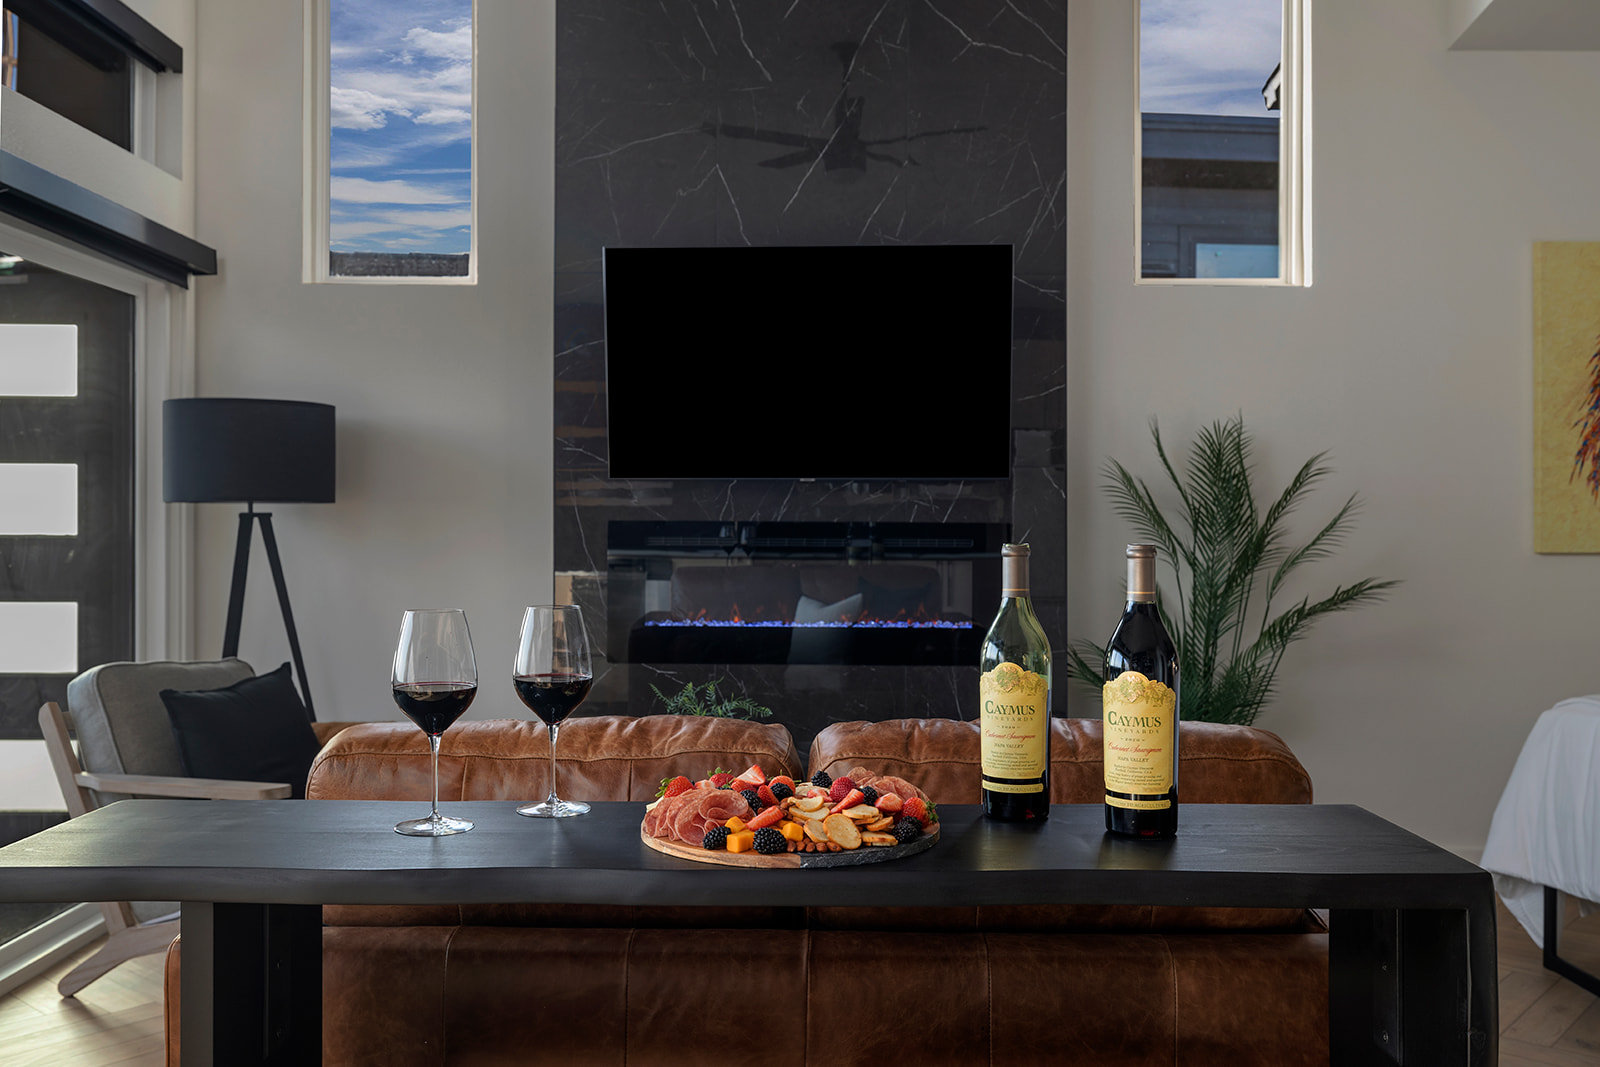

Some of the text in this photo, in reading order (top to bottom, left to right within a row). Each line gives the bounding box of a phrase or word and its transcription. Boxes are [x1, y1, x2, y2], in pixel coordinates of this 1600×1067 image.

[985, 700, 1035, 716] CAYMUS
[1108, 711, 1162, 728] CAYMUS
[984, 729, 1037, 743] Cabernet Sauvignon
[1108, 741, 1162, 757] Cabernet Sauvignon
